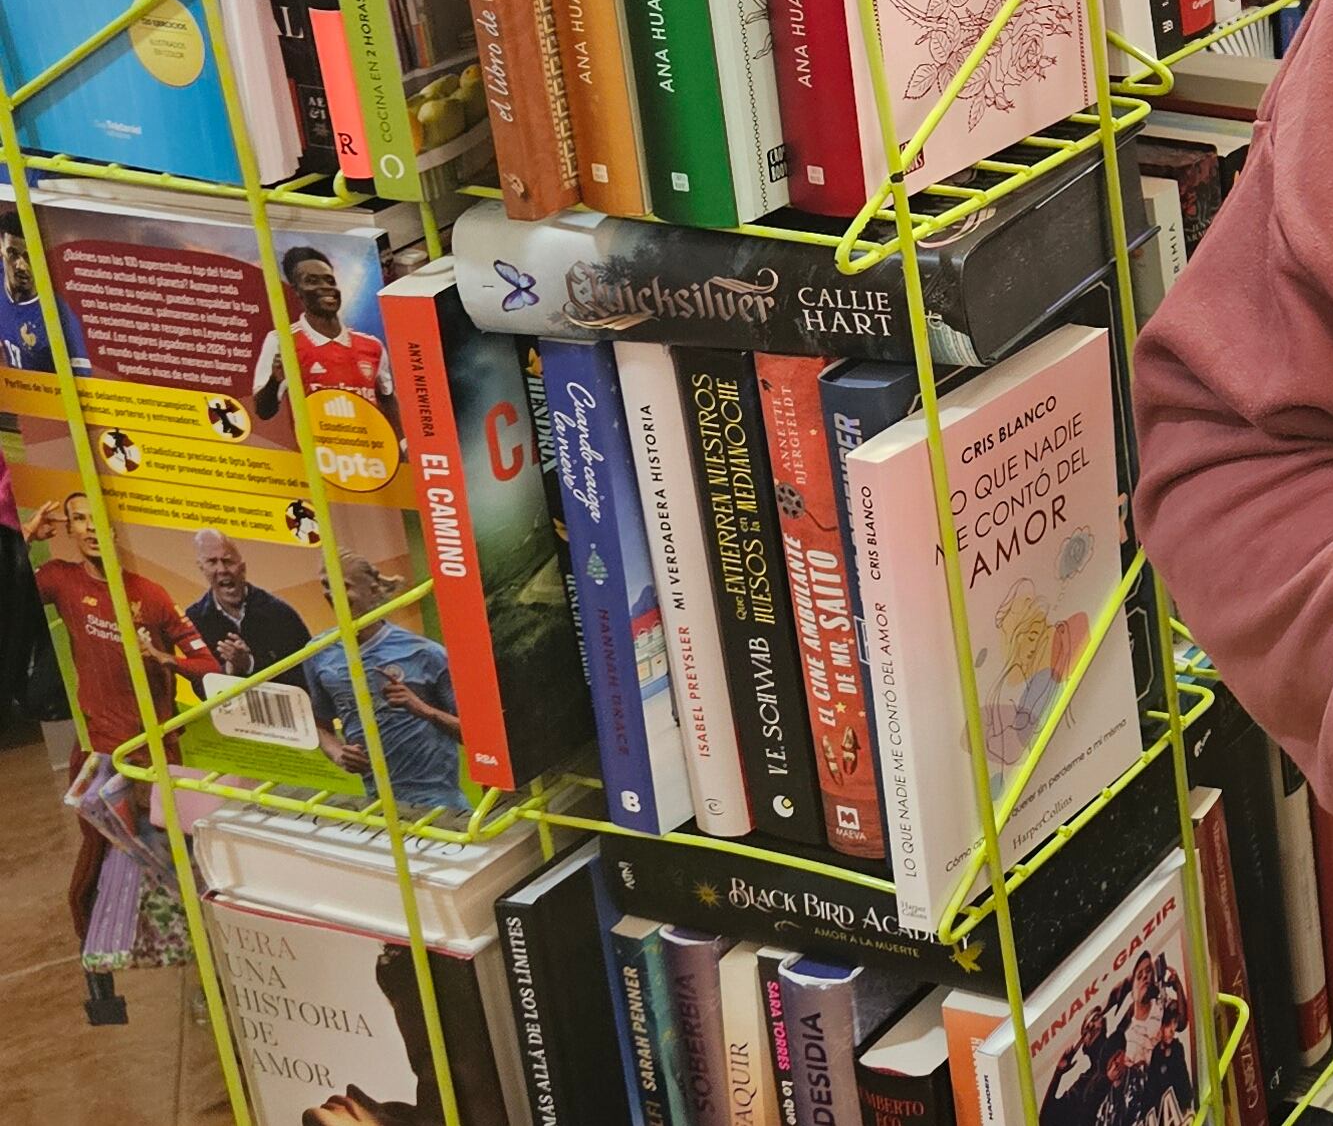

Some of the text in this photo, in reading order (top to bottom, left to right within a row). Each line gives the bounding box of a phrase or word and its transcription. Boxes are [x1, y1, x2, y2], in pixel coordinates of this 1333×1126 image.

[573, 41, 593, 86] ANA
[651, 48, 676, 94] ANA
[789, 44, 814, 89] ANA
[561, 261, 780, 331] Quicksilver
[796, 286, 892, 314] CALLIE
[802, 309, 893, 338] HART
[960, 395, 1058, 466] CRIS BLANCO
[973, 412, 1084, 501] QUE NADIE
[419, 452, 468, 579] EL CAMINO
[640, 404, 686, 612] MI VERDADERA HISTORIA
[691, 372, 747, 596] ENTIERREN NUESTROS
[716, 376, 777, 626] HUESOS MEDIANOCHE
[974, 446, 1092, 539] CONTÓ DEL
[861, 485, 882, 582] CRIS BLANCO
[968, 493, 1068, 591] AMOR
[782, 531, 837, 727] EL CINE AMBULANTE
[676, 625, 712, 758] ISABEL PREYSLER
[1011, 794, 1074, 852] HarperCollins
[223, 953, 287, 991] UNA
[230, 983, 375, 1039] HISTORIA
[1028, 895, 1178, 1059] MNAK GAZIR
[239, 1015, 279, 1048] DE
[248, 1047, 335, 1090] AMOR
[621, 965, 659, 1094] SARAH PENNER
